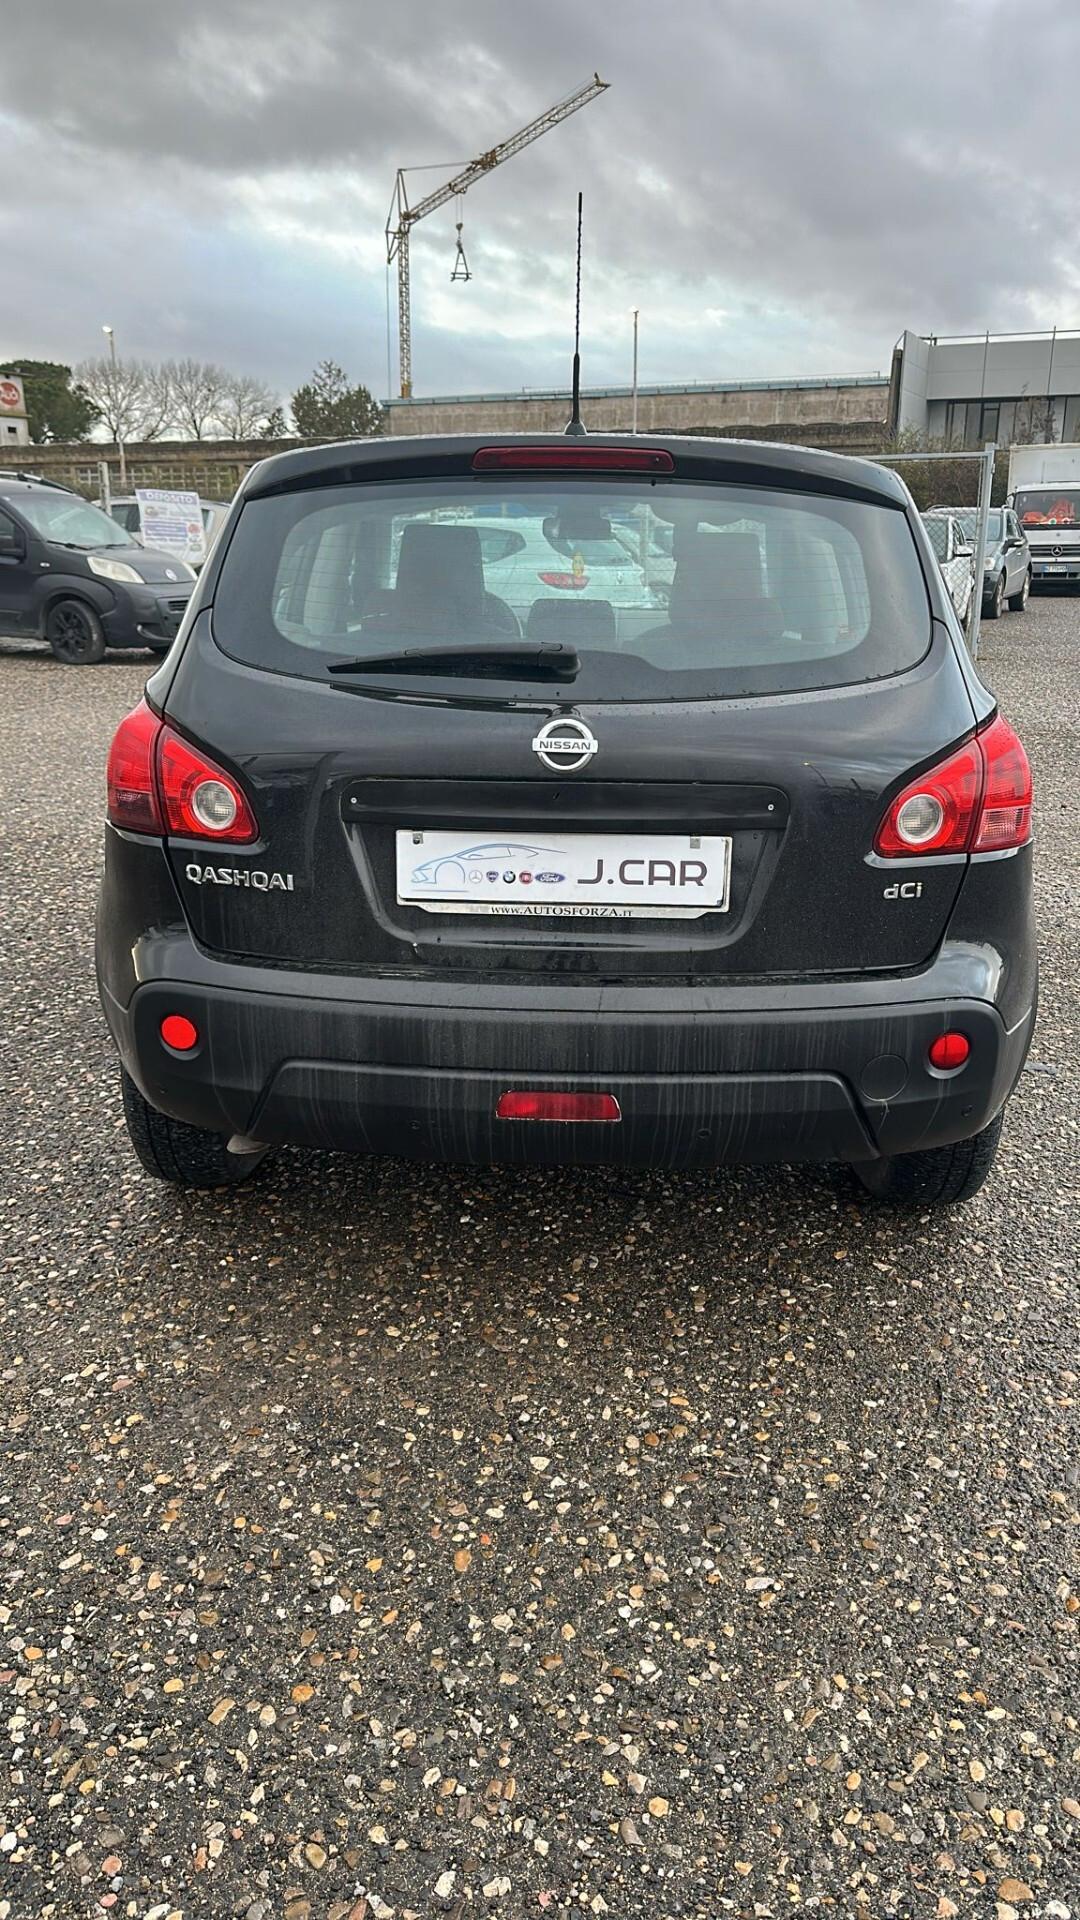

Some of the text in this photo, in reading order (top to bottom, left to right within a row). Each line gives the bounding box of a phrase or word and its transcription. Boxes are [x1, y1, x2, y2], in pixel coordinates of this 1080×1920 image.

[539, 740, 591, 751] NISSAN
[185, 863, 294, 891] QASHQAI
[577, 859, 708, 887] J.CAR
[883, 882, 923, 899] dCi
